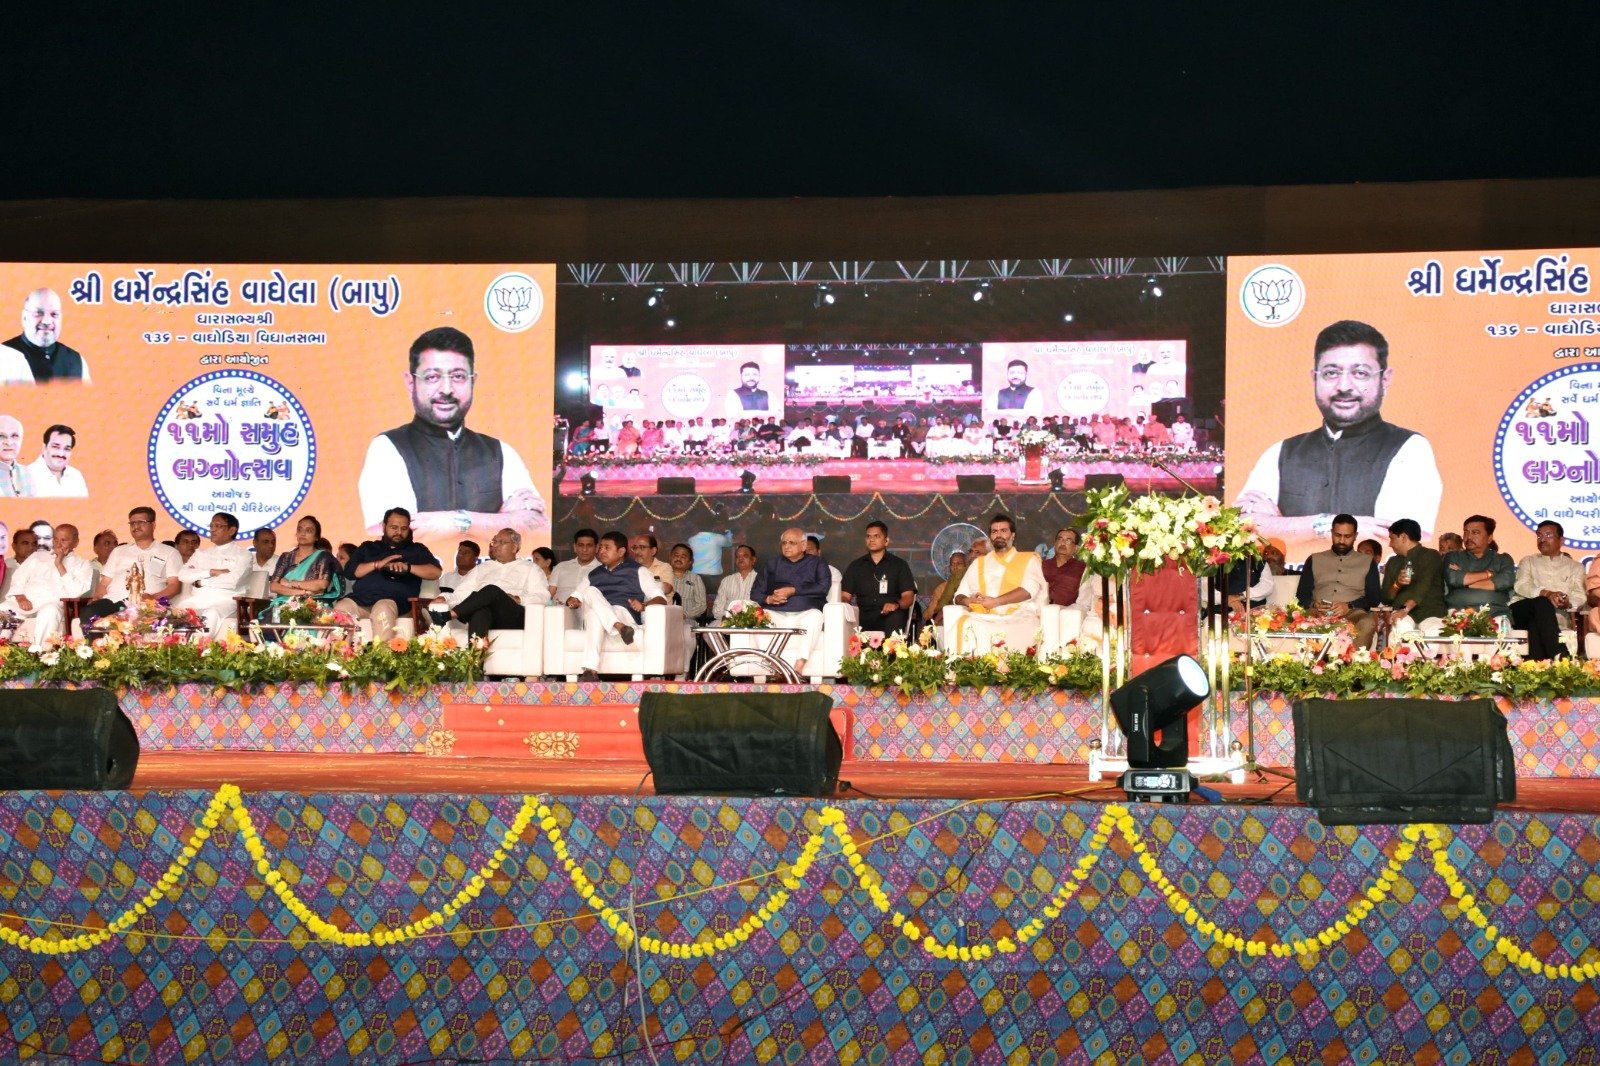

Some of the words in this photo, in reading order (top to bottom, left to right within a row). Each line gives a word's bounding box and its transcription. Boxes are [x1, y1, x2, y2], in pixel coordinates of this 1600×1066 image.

[1407, 261, 1442, 294] શ્રી
[1455, 255, 1589, 295] ધર્મેન્દ્રસિંહ
[71, 272, 102, 303] શ્રી
[113, 270, 229, 306] ધર્મેન્દ્રસિંહ
[241, 271, 316, 304] વાઘેલા
[330, 276, 400, 315] (બાપુ)
[1550, 303, 1600, 314] ધારાસ
[197, 311, 273, 325] ધારાસભ્યશ્રી
[144, 333, 170, 343] ૧૩૬
[192, 329, 250, 343] વાઘોડિયા
[256, 329, 325, 344] વિધાનસભા
[1487, 325, 1518, 336] ૧૩૬
[1553, 347, 1580, 359] દ્વારા
[200, 354, 222, 365] દ્વારા
[212, 383, 233, 394] વિના
[1569, 379, 1593, 390] વિના
[223, 396, 238, 407] ધર્મ
[1582, 392, 1600, 404] ધર્મ
[167, 413, 229, 444] ૧૧મો
[240, 422, 300, 454] સમુહ
[1515, 411, 1589, 445] ૧૧મો
[172, 447, 293, 482] લગ્નોત્સવ
[211, 488, 251, 499] આયોજક
[1569, 492, 1600, 504] આયો
[181, 502, 194, 512] શ્રી
[197, 501, 237, 513] વાઘેશ્વરી
[241, 502, 281, 512] ચેરિટેબલ
[1534, 507, 1549, 519] શ્રી
[1553, 506, 1600, 519] વાઘેશ્વરી
[1582, 525, 1600, 537] ટ્રસ્
